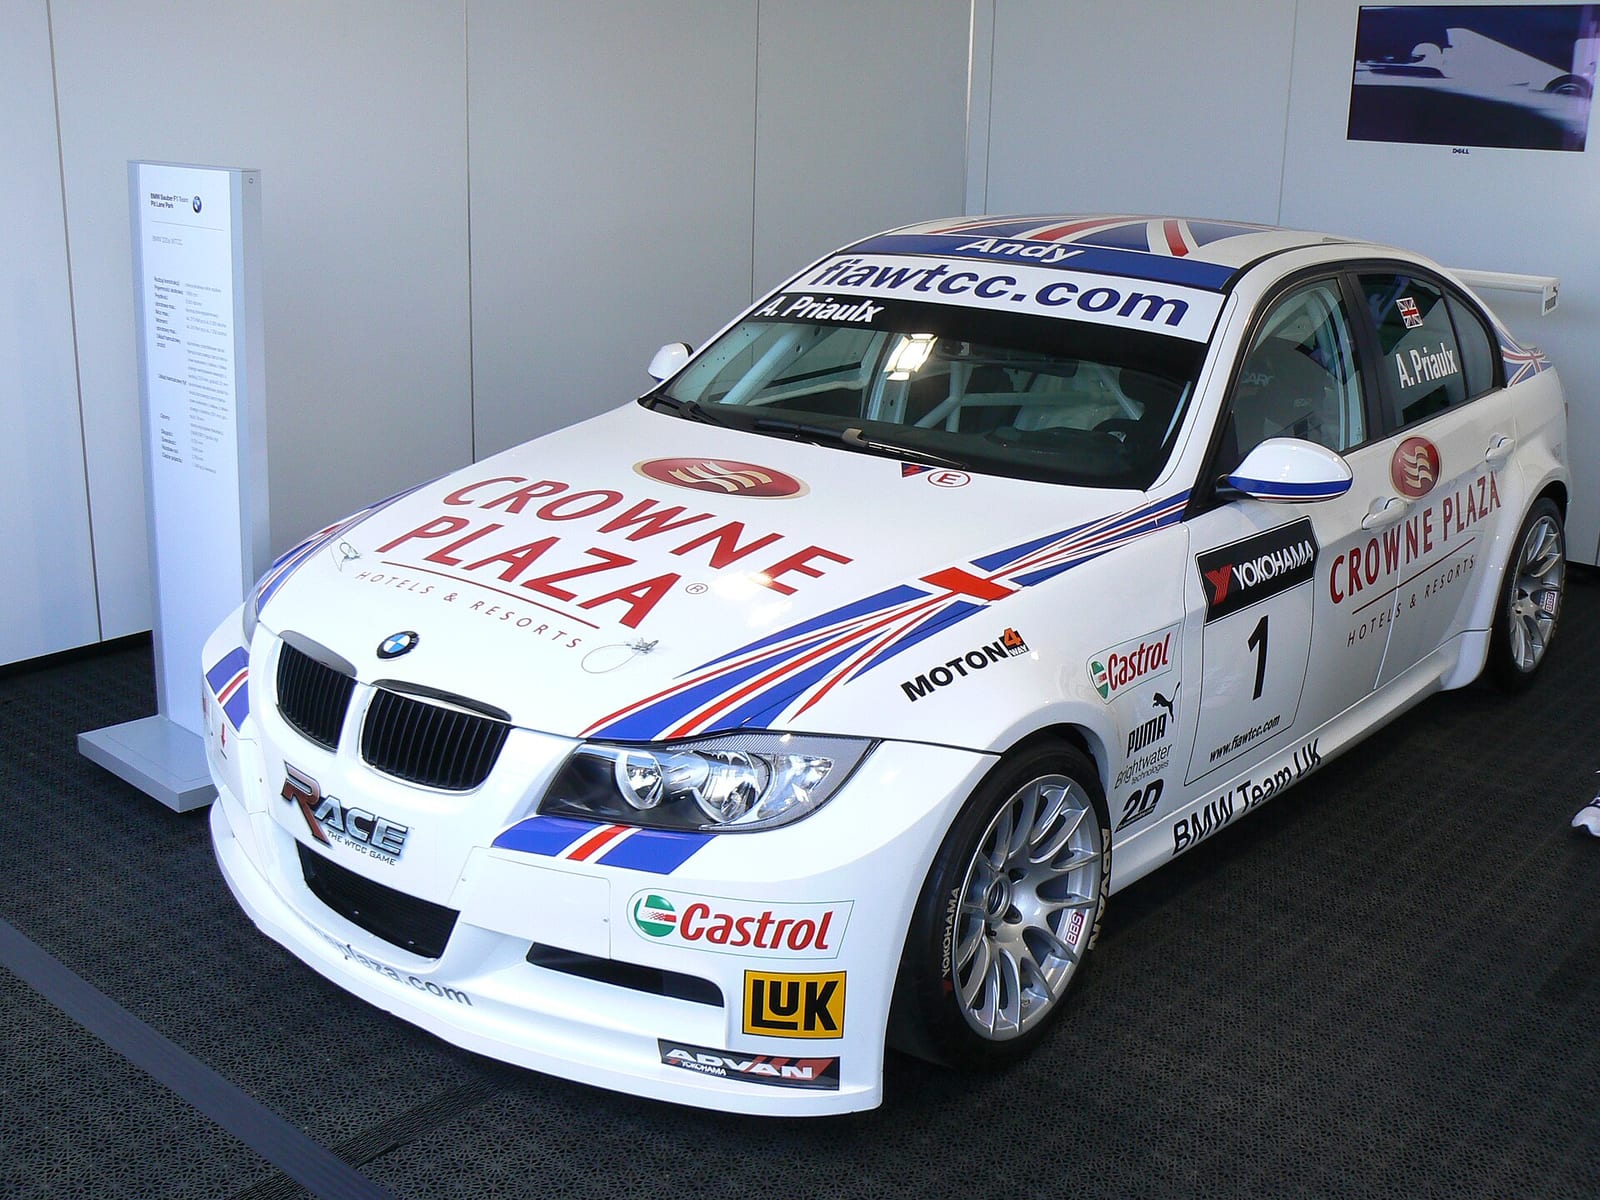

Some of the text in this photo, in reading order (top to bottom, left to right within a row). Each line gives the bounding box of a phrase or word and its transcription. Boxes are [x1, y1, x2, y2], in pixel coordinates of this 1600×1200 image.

[956, 238, 1086, 262] Andy
[754, 295, 885, 323] A. Priaulx
[807, 258, 1190, 327] fiawtcc.com
[1395, 342, 1458, 389] A. Priaulx
[937, 473, 961, 485] E
[443, 476, 855, 596] CROWNE
[1232, 540, 1314, 590] YOKOHAMA
[1329, 470, 1501, 604] CROWNE PLAZA
[374, 515, 682, 629] PLAZA
[1347, 554, 1475, 648] HOTELS & RESORTS
[355, 571, 582, 649] HOTELS & RESORTS
[900, 641, 1009, 702] MOTON
[1107, 632, 1171, 691] Castrol
[1247, 615, 1268, 700] 1
[1127, 713, 1167, 758] PUMA
[1210, 715, 1281, 763] www.fiawtcc.com
[281, 760, 409, 857] RACE
[1172, 737, 1322, 856] BMW Team UK
[328, 831, 343, 843] THE
[369, 850, 397, 866] GAME
[679, 902, 834, 950] Castrol
[942, 888, 960, 978] YOKOHAMA
[666, 1048, 814, 1080] ADVAN
[681, 1060, 727, 1076] YOKOHAMA
